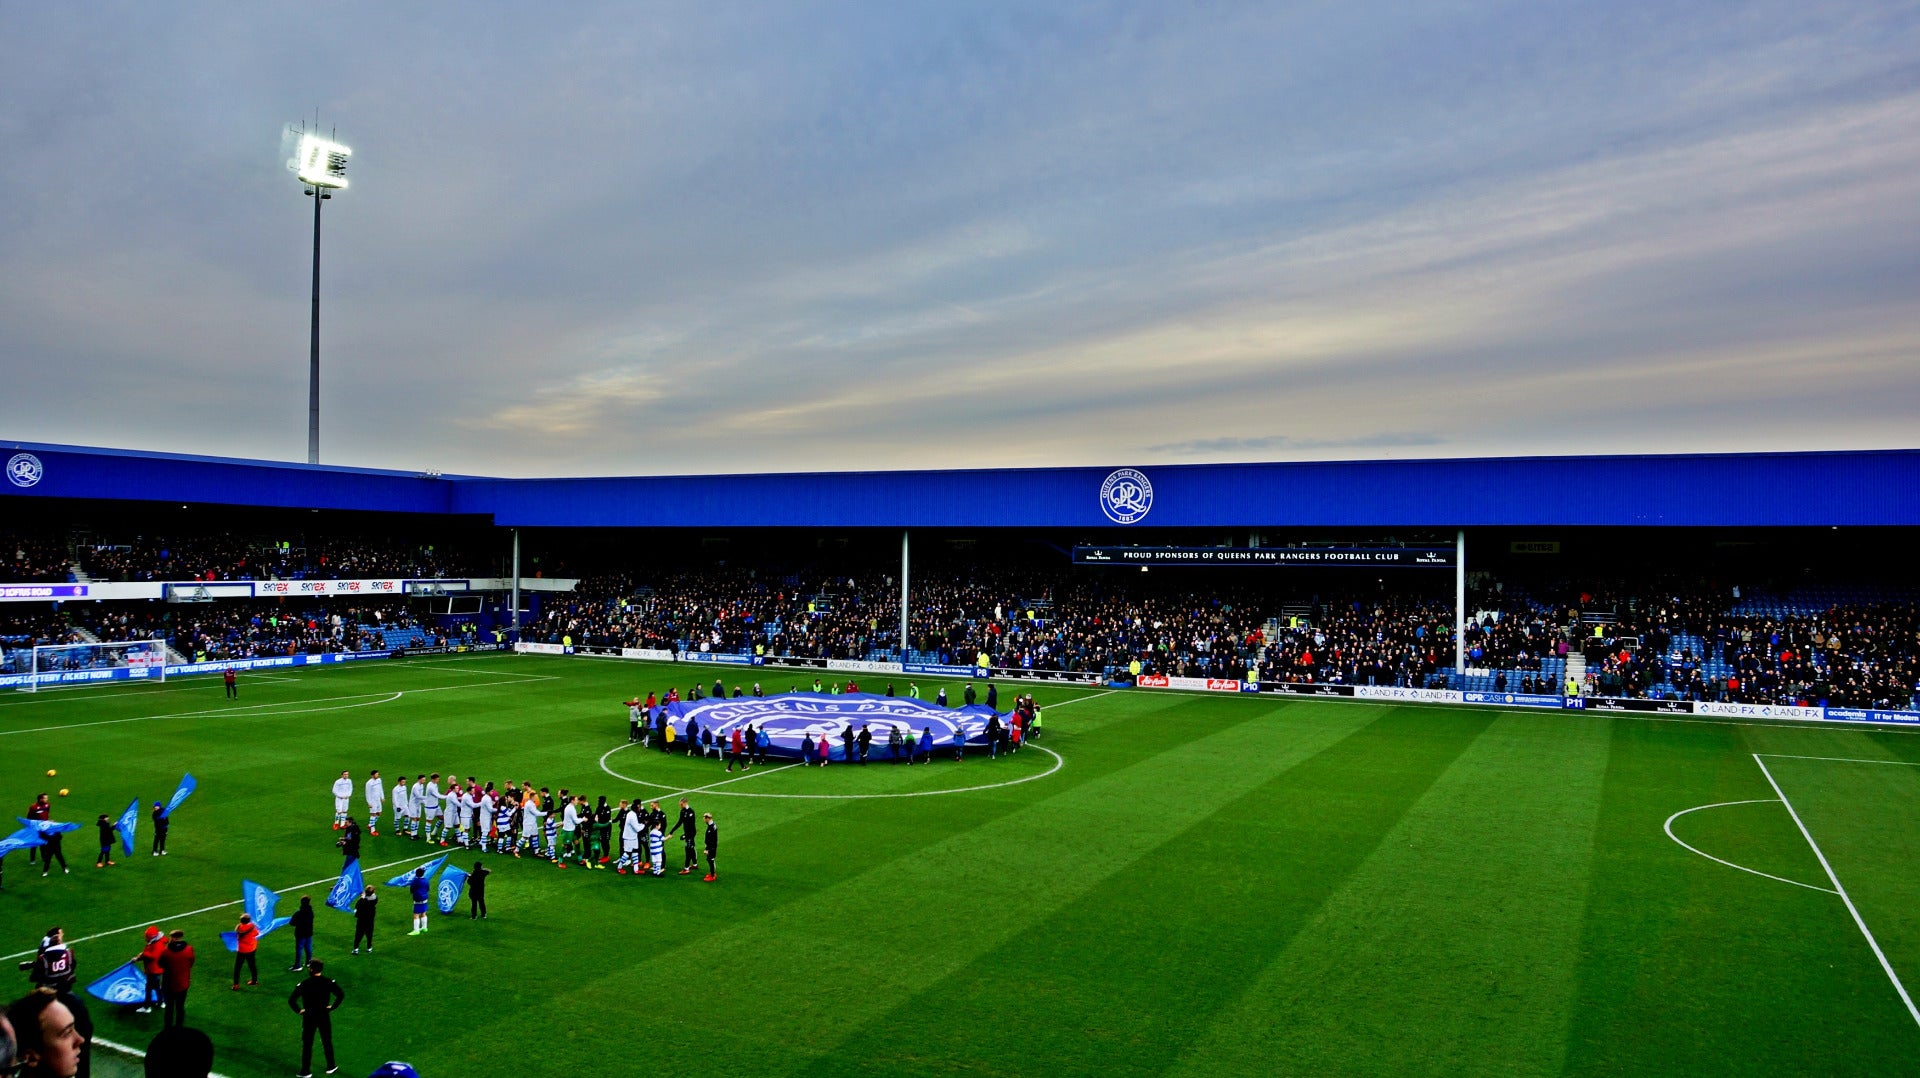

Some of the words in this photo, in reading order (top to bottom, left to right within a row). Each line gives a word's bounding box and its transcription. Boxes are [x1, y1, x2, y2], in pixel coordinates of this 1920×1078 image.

[1217, 552, 1251, 560] QUEENS
[754, 656, 763, 664] P7
[977, 669, 987, 677] P8
[1243, 683, 1258, 691] P10
[1566, 698, 1583, 707] P11
[709, 702, 840, 720] QUEENS
